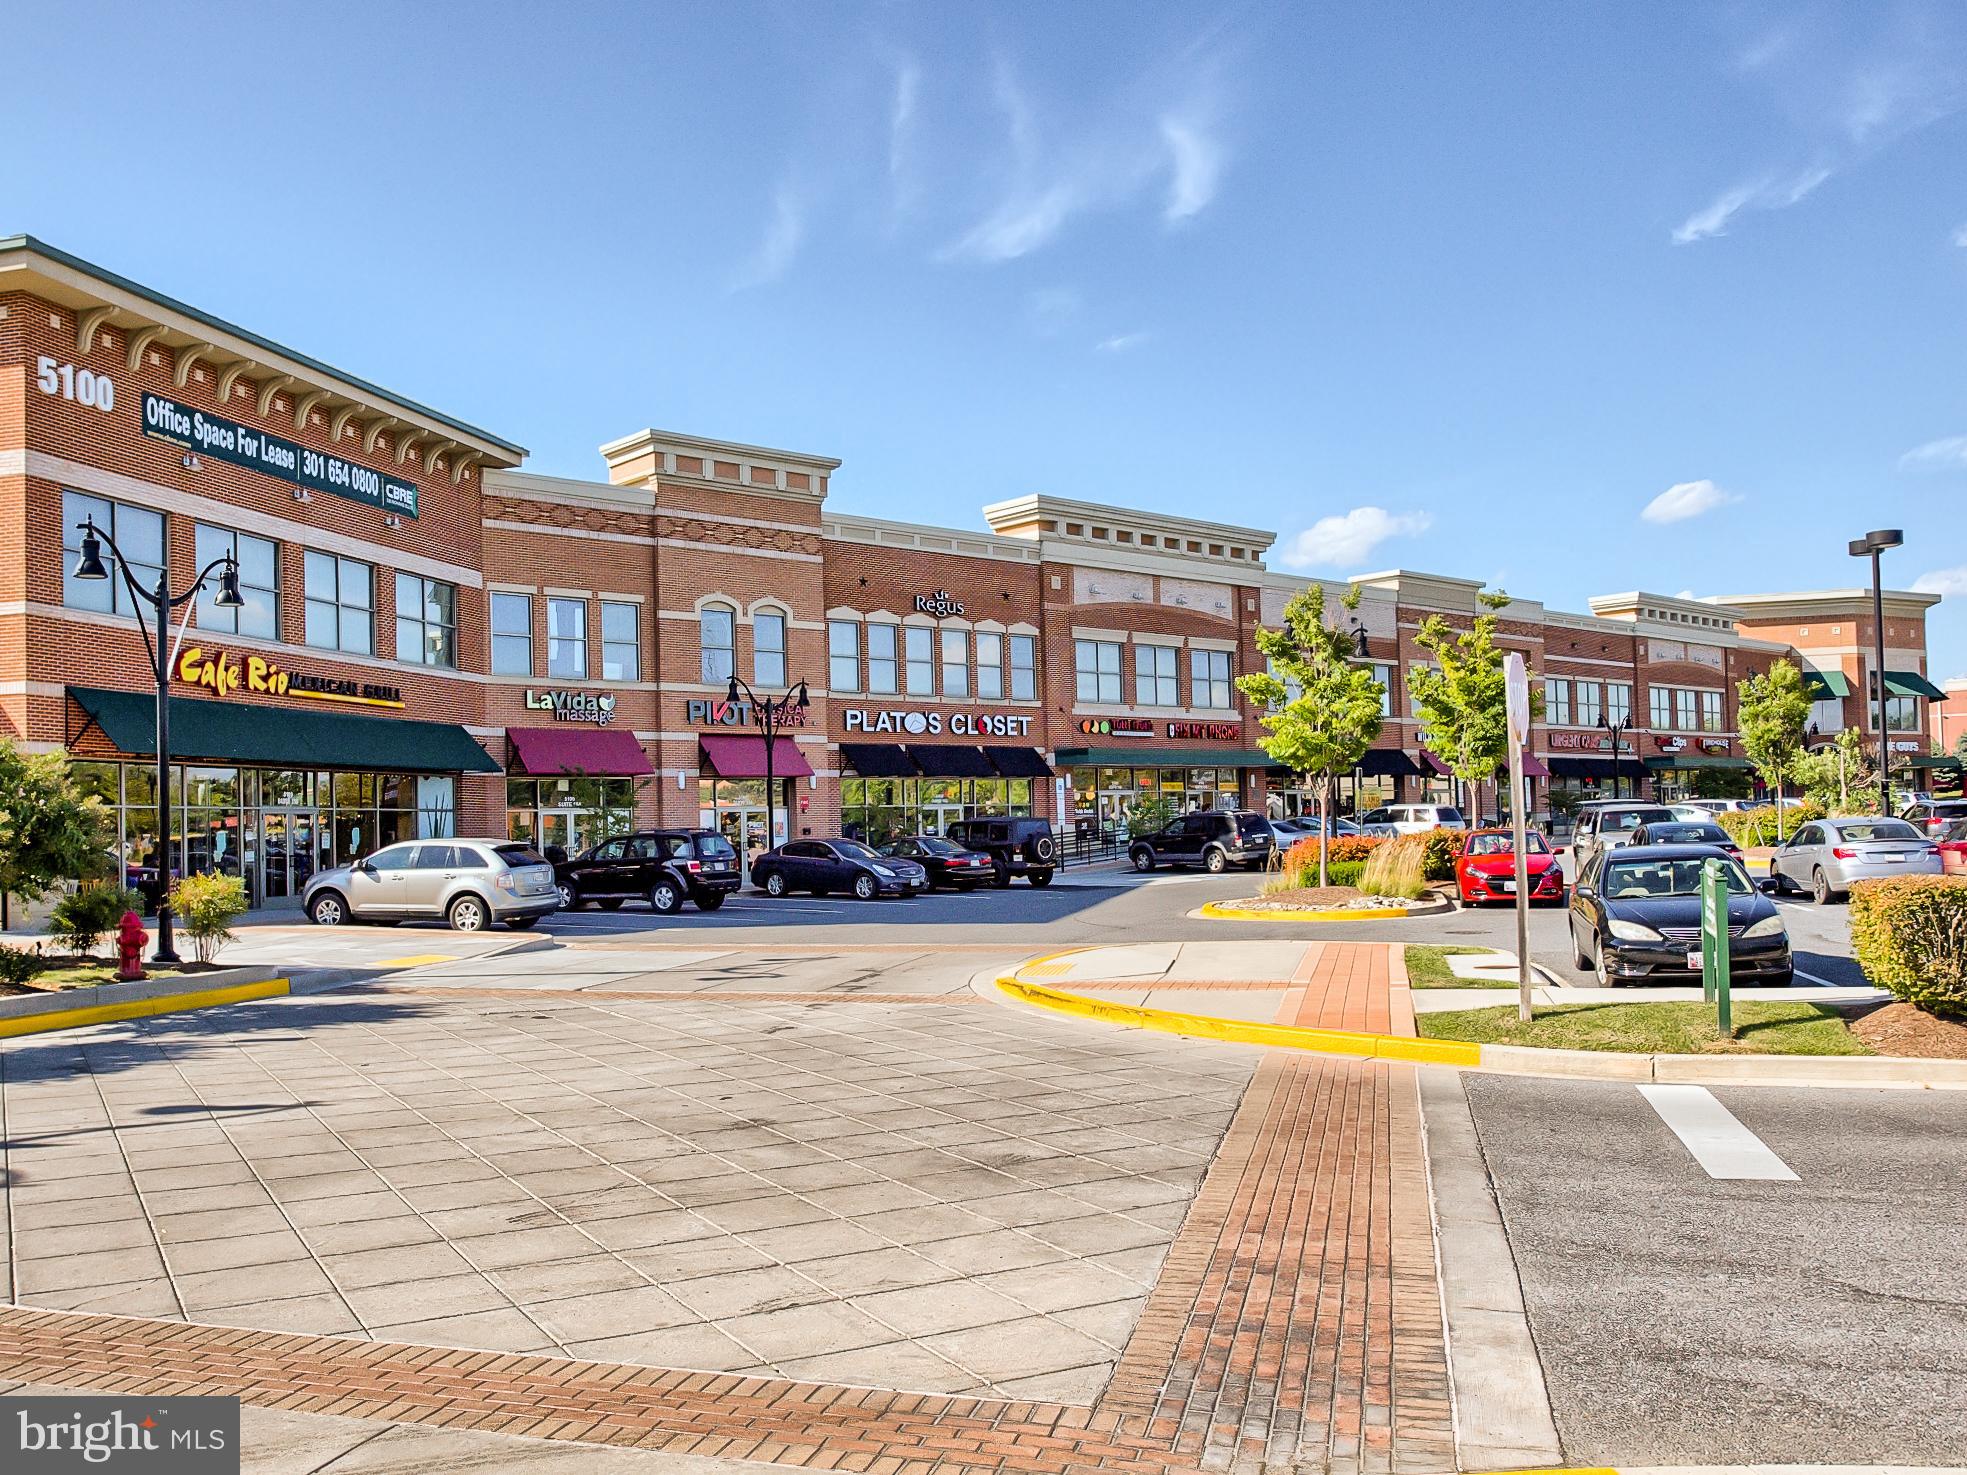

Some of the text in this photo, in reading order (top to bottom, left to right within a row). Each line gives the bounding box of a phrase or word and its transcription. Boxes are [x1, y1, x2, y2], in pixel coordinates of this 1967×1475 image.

[37, 356, 114, 412] 5100
[147, 397, 379, 497] Office Space For Lease 301 654 0800
[386, 485, 413, 506] CBRE
[916, 596, 965, 617] Regus
[180, 648, 239, 696] Cafe
[248, 656, 288, 694] Rio
[526, 690, 599, 711] LaVida
[689, 700, 751, 725] PIVOT
[556, 709, 616, 727] massage
[846, 710, 1034, 736] PLATO'S CLOSET
